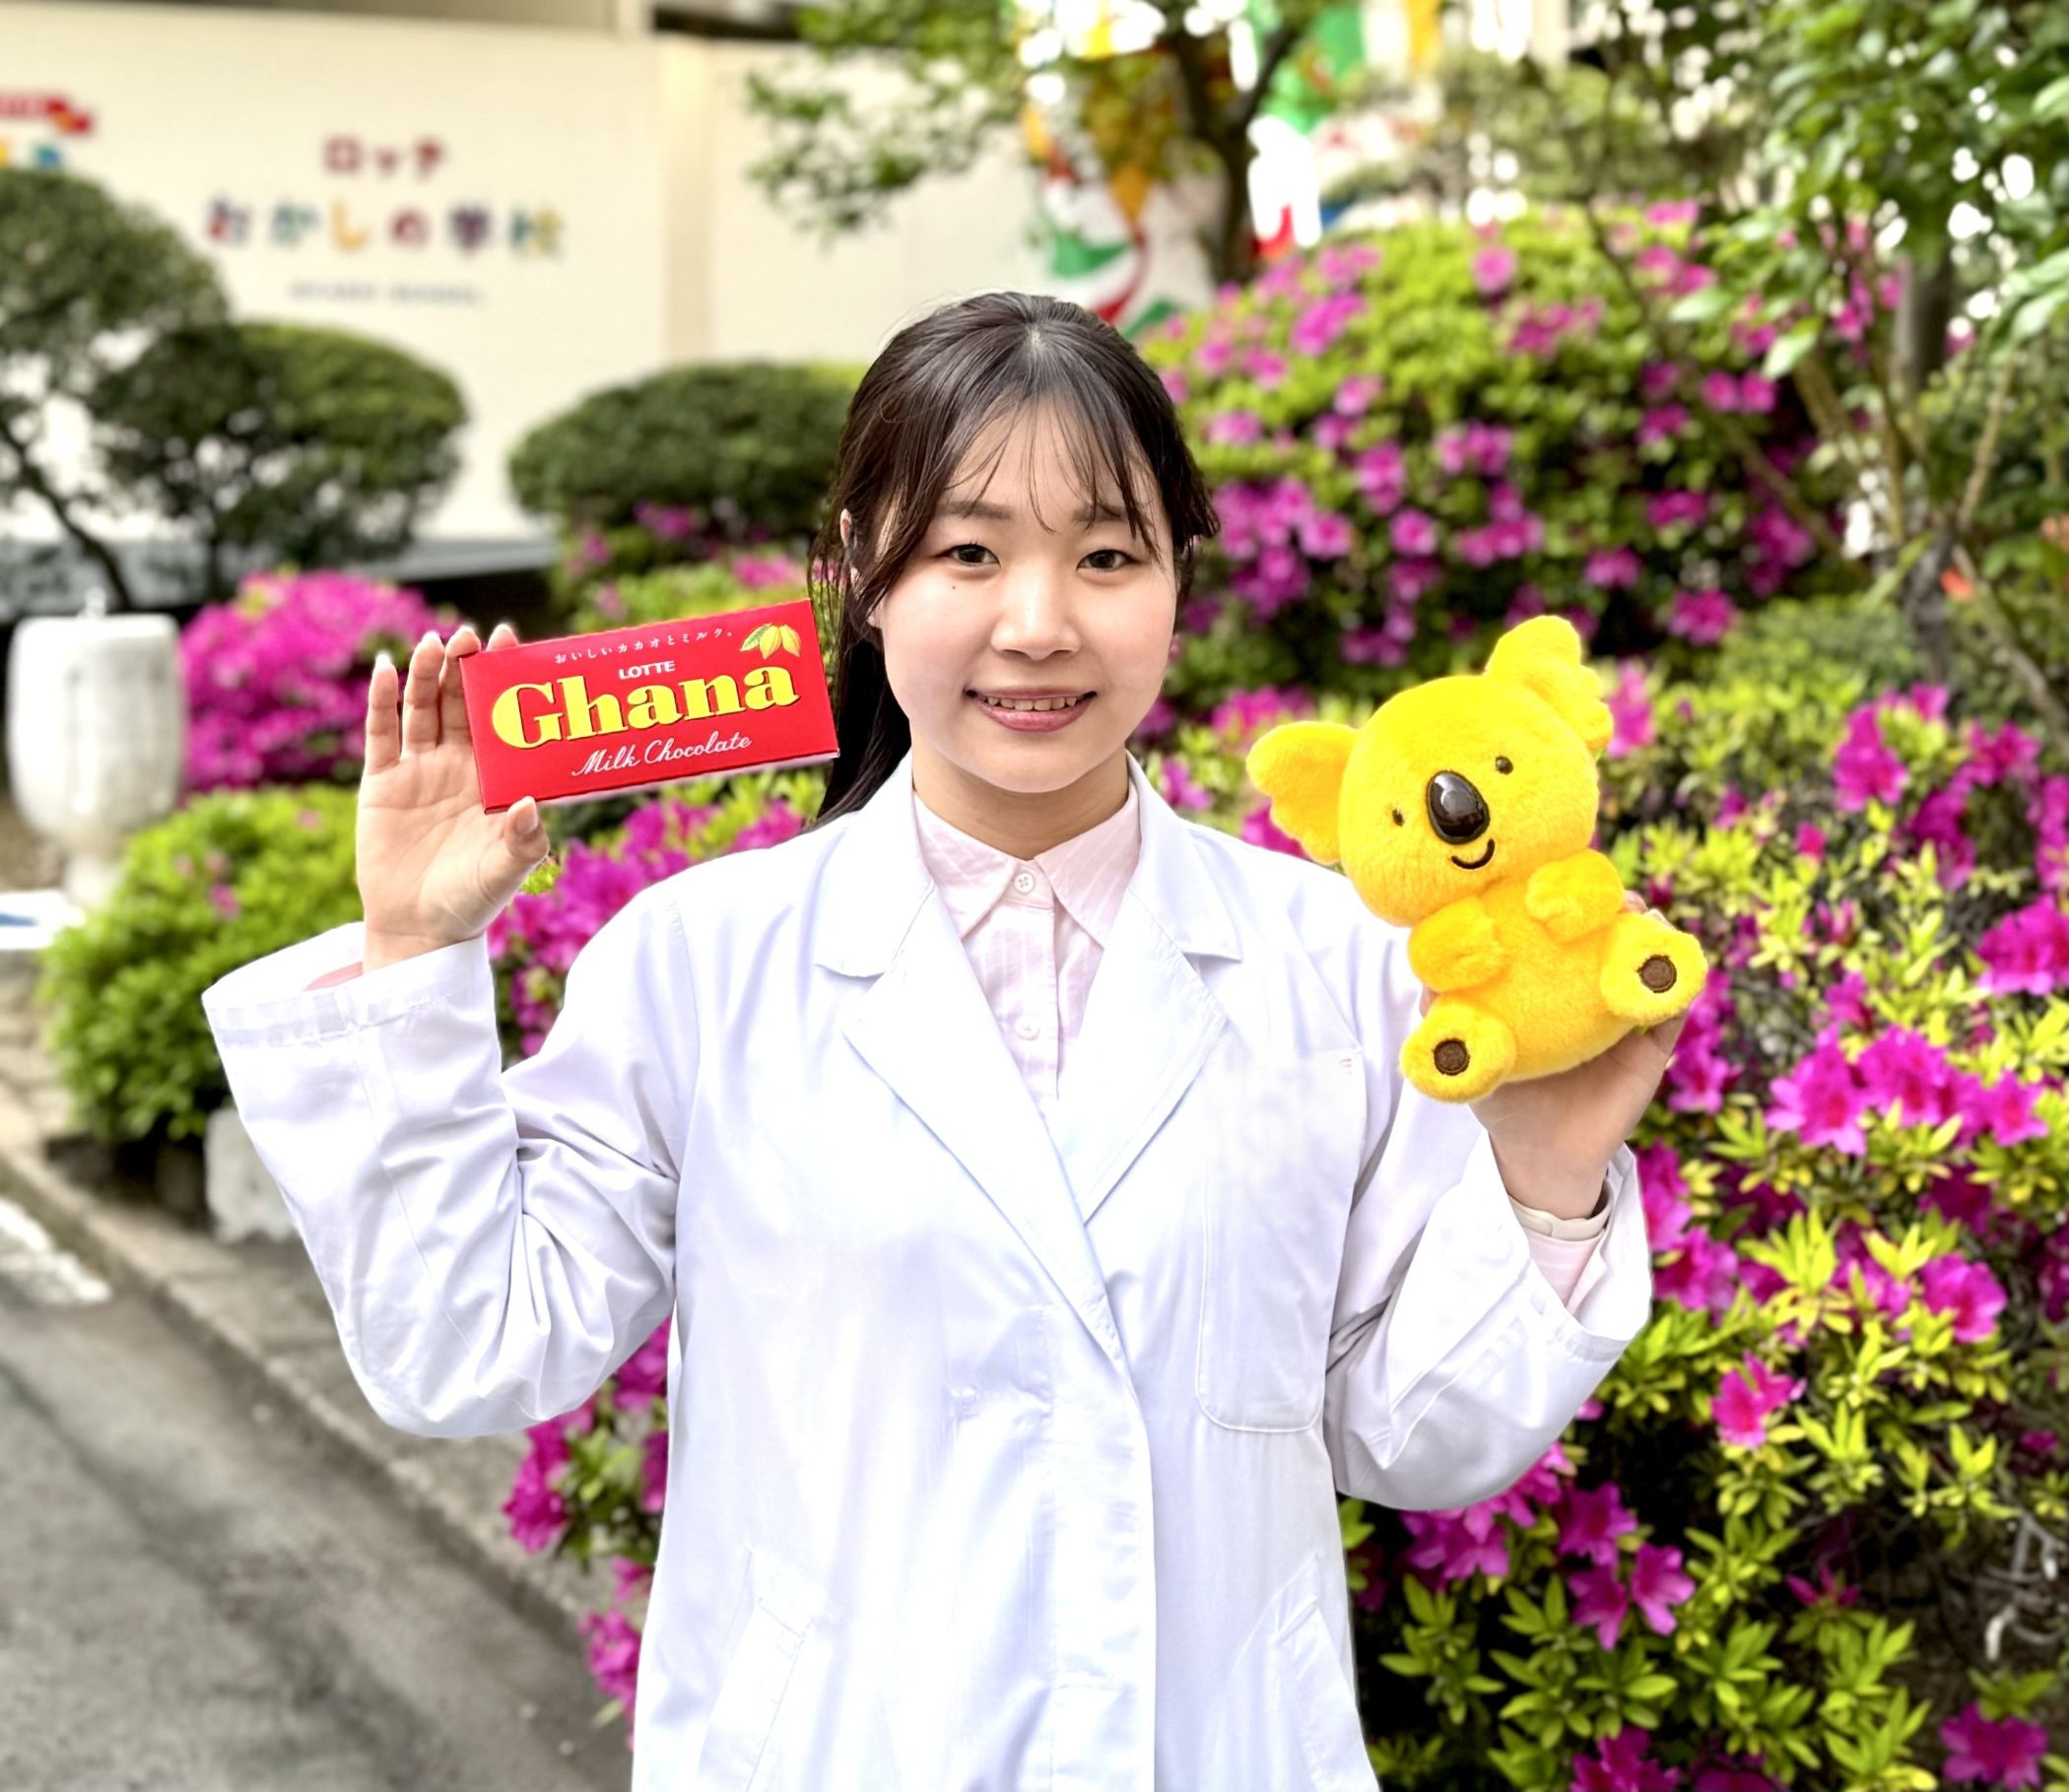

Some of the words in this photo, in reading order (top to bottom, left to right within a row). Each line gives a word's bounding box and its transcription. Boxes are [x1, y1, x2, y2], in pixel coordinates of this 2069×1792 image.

[323, 136, 446, 179] ロッテ
[555, 628, 733, 664] おいしいカカオとミルク。
[619, 660, 676, 680] LOTTE
[492, 666, 801, 749] Ghana
[571, 744, 640, 776] Milk
[644, 730, 753, 764] Chocolate
